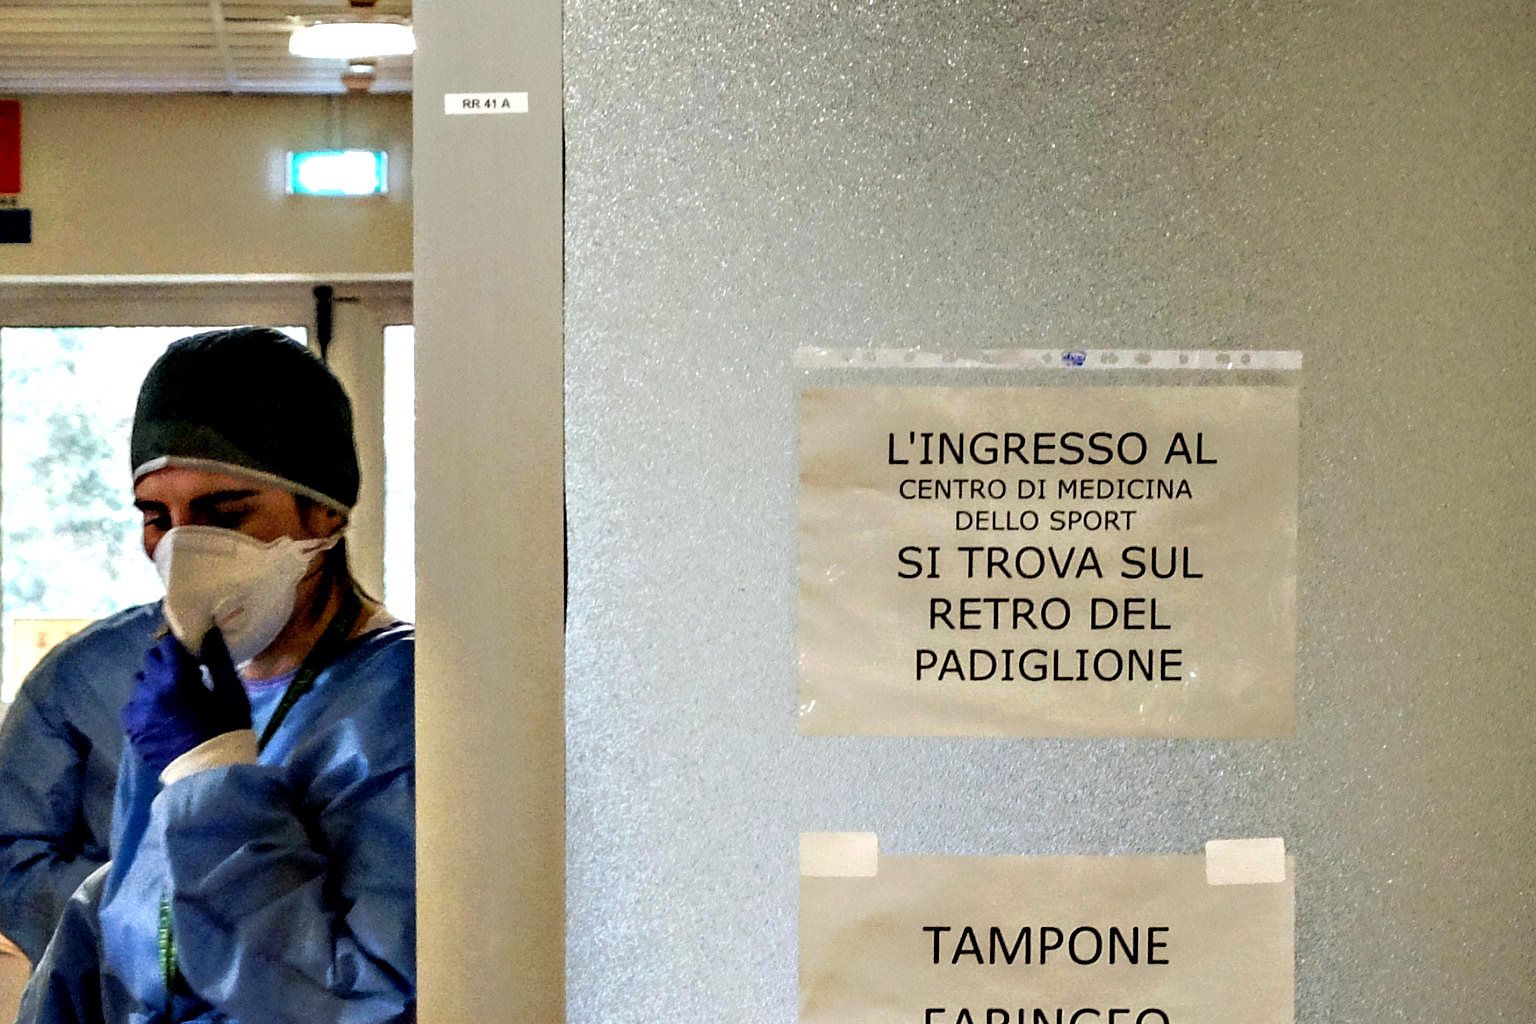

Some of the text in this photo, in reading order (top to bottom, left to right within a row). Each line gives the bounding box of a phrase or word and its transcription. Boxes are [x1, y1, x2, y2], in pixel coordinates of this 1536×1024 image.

[462, 98, 511, 109] RR 41 A
[888, 431, 1218, 466] L'INGRESSO AL
[899, 478, 1193, 500] CENTRO DI MEDICINA
[955, 510, 1137, 531] DELLO SPORT
[897, 545, 1204, 579] SI TROVA SUL
[929, 597, 1172, 630] RETRO DEL
[915, 648, 1183, 682] PADIGLIONE
[922, 926, 1170, 966] TAMPONE
